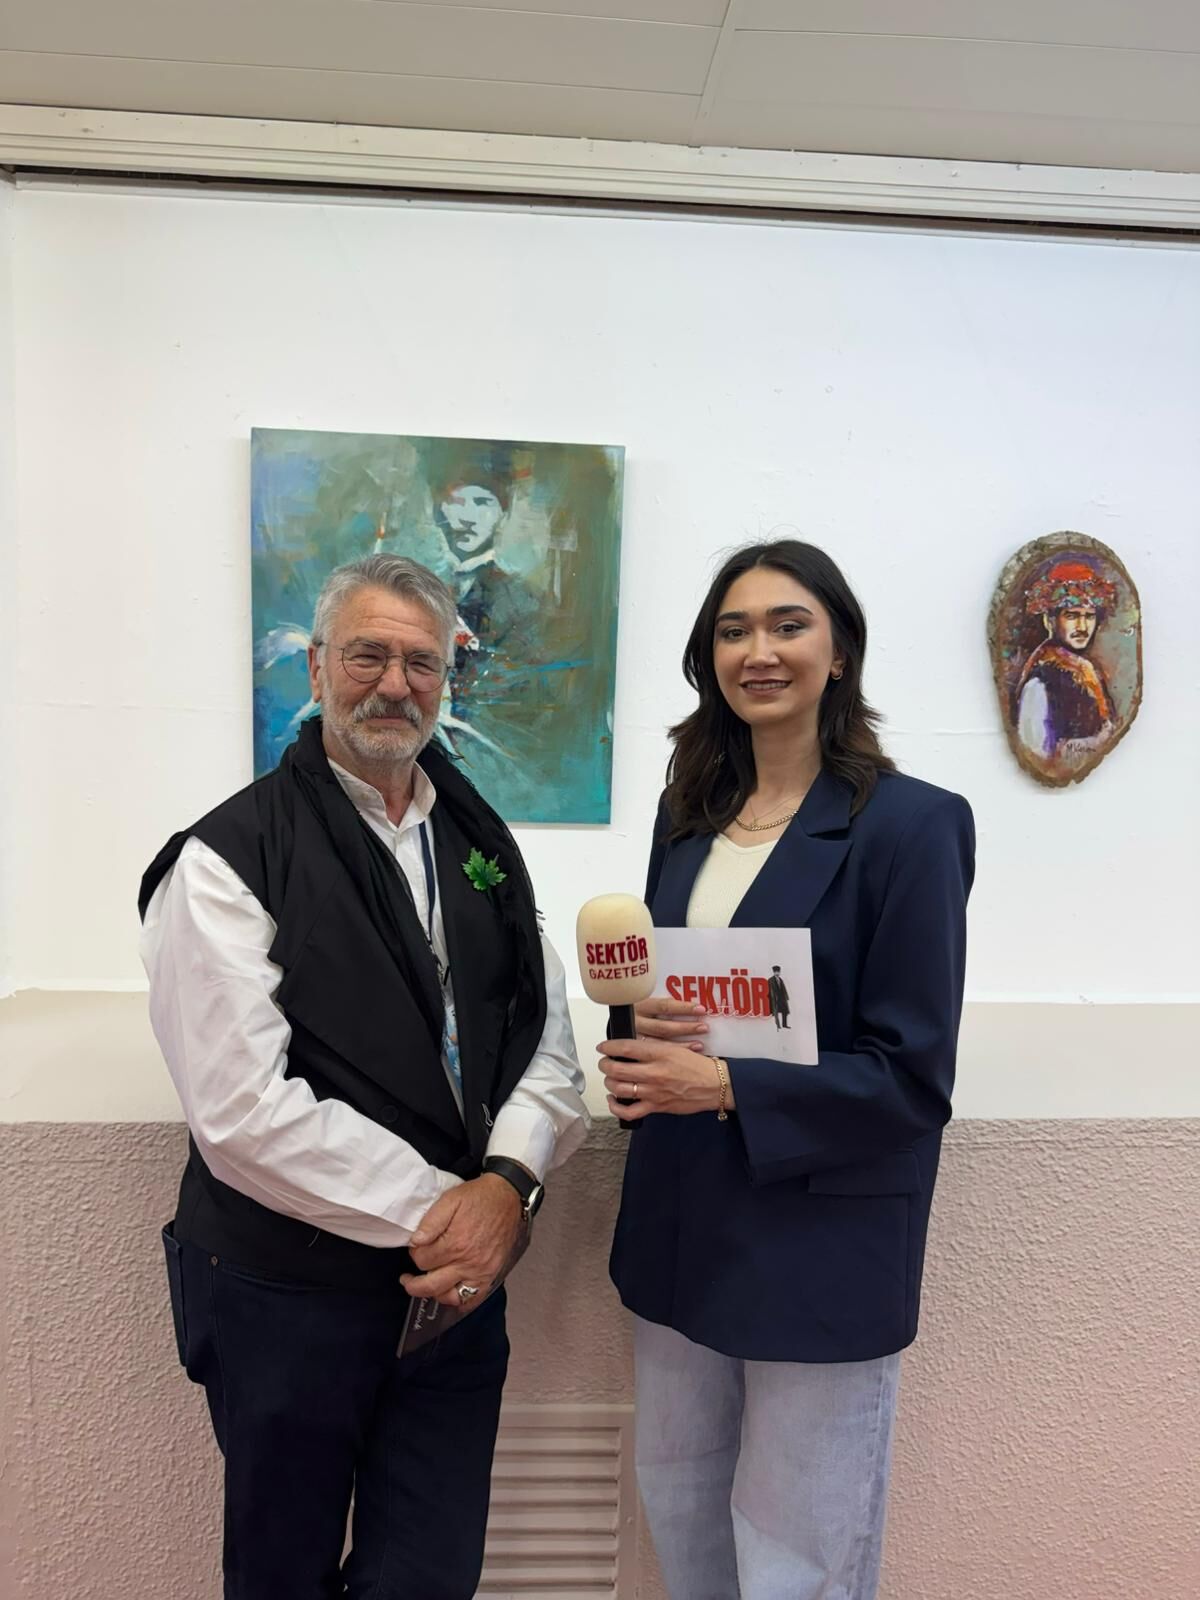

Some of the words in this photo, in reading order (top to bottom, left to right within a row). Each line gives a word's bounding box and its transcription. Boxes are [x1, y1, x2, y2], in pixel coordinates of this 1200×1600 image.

[586, 934, 649, 966] SEKTÖR
[589, 961, 649, 980] GAZETESİ
[666, 969, 771, 1017] SEKTÖR
